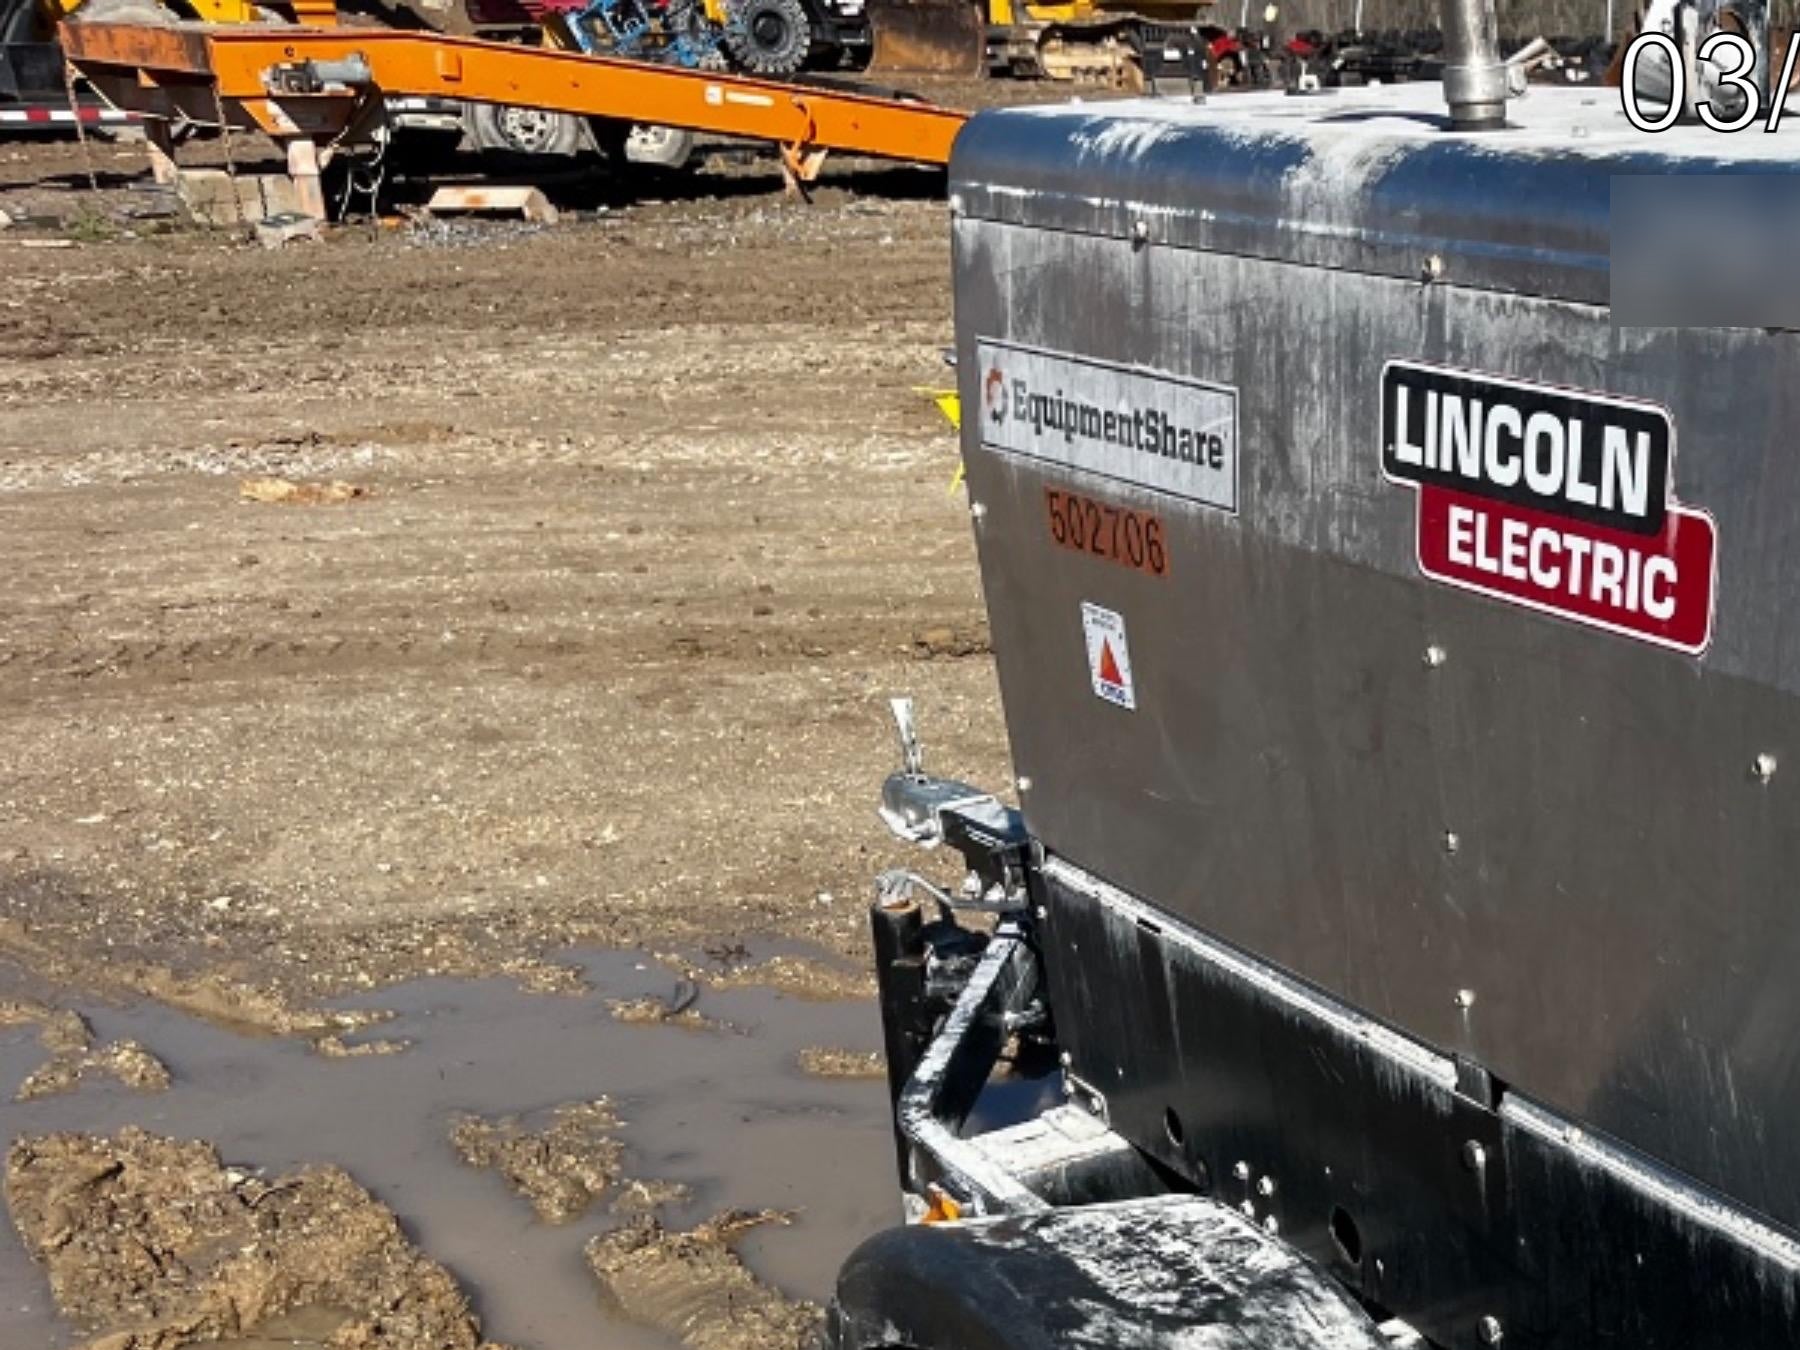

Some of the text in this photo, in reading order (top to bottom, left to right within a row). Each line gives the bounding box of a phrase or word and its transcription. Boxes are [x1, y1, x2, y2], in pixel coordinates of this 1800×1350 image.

[1011, 376, 1224, 470] EquipmentShare
[1395, 383, 1650, 517] LINCOLN
[1049, 491, 1164, 573] 502706
[1448, 503, 1678, 620] ELECTRIC
